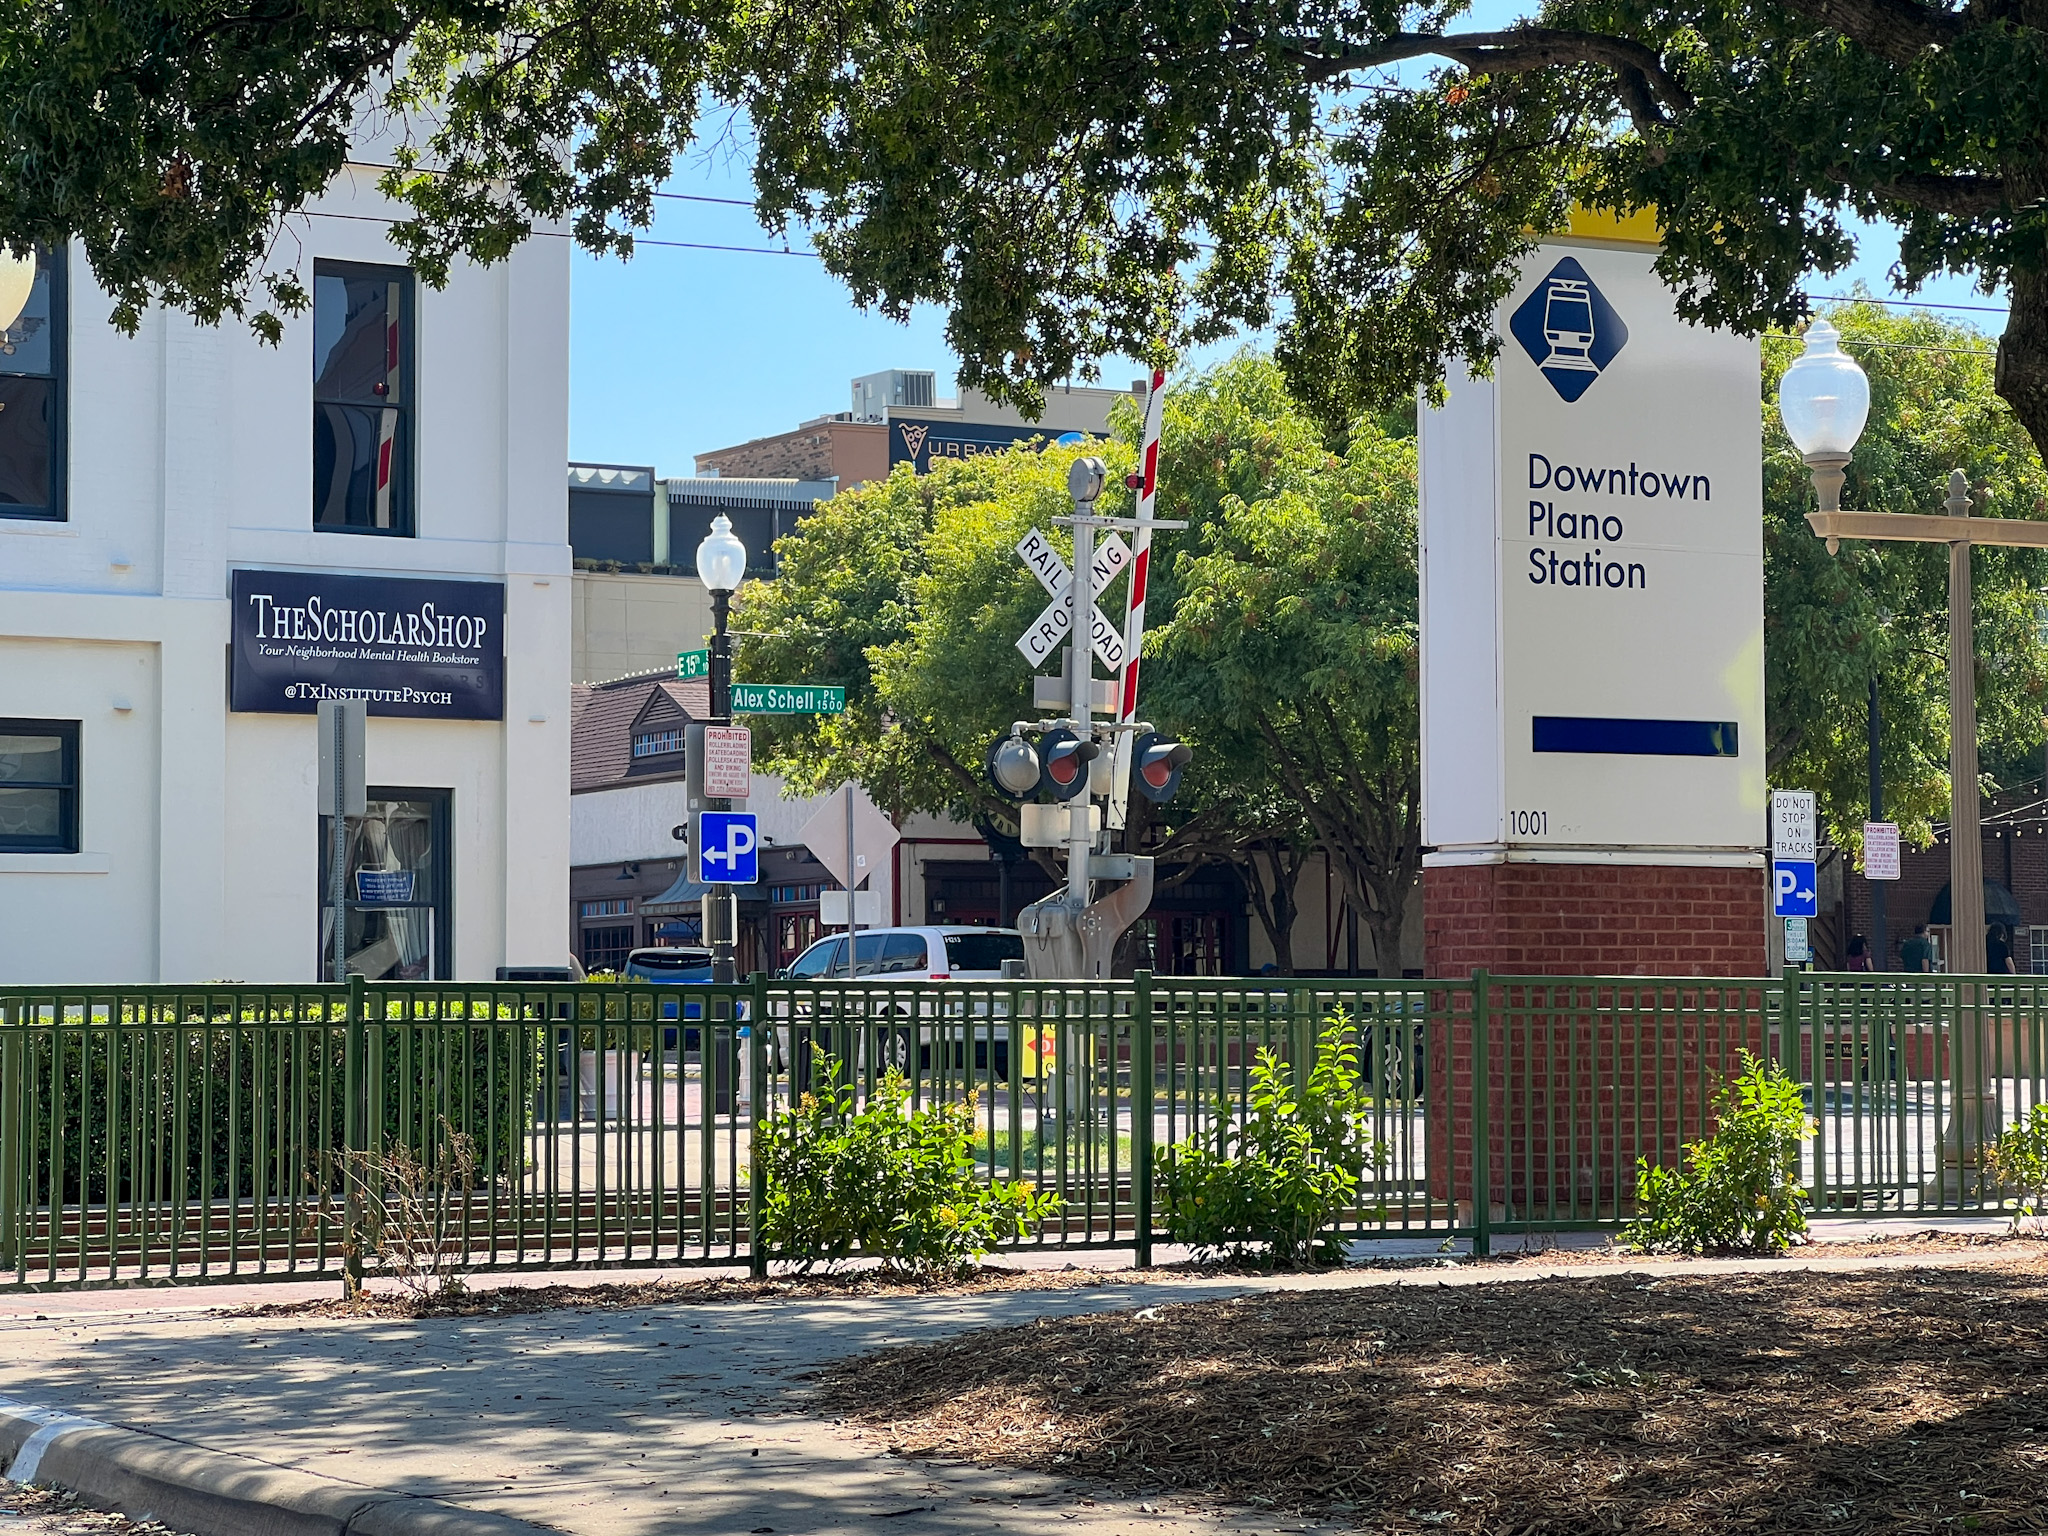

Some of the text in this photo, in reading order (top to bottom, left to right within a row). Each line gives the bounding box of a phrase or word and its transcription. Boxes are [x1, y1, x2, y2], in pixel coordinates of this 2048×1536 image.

[1529, 453, 1710, 501] Downtown
[1529, 500, 1623, 541] Plano
[1023, 535, 1062, 590] RAIL
[1528, 547, 1646, 589] Station
[258, 643, 480, 665] Your Neighborhood Mental Health Bookstore
[678, 656, 685, 676] E
[733, 687, 814, 710] Alex Schell
[823, 689, 836, 700] PL
[817, 700, 843, 711] 1500
[709, 732, 747, 740] PROHIBITED
[708, 749, 747, 757] SKATEBOARDING
[1776, 798, 1811, 809] DO NOT
[1510, 810, 1547, 835] 1001
[1781, 813, 1806, 823] STOP
[1787, 827, 1801, 838] ON
[727, 824, 756, 870] P
[1775, 841, 1813, 853] TRACKS
[1776, 869, 1797, 907] P
